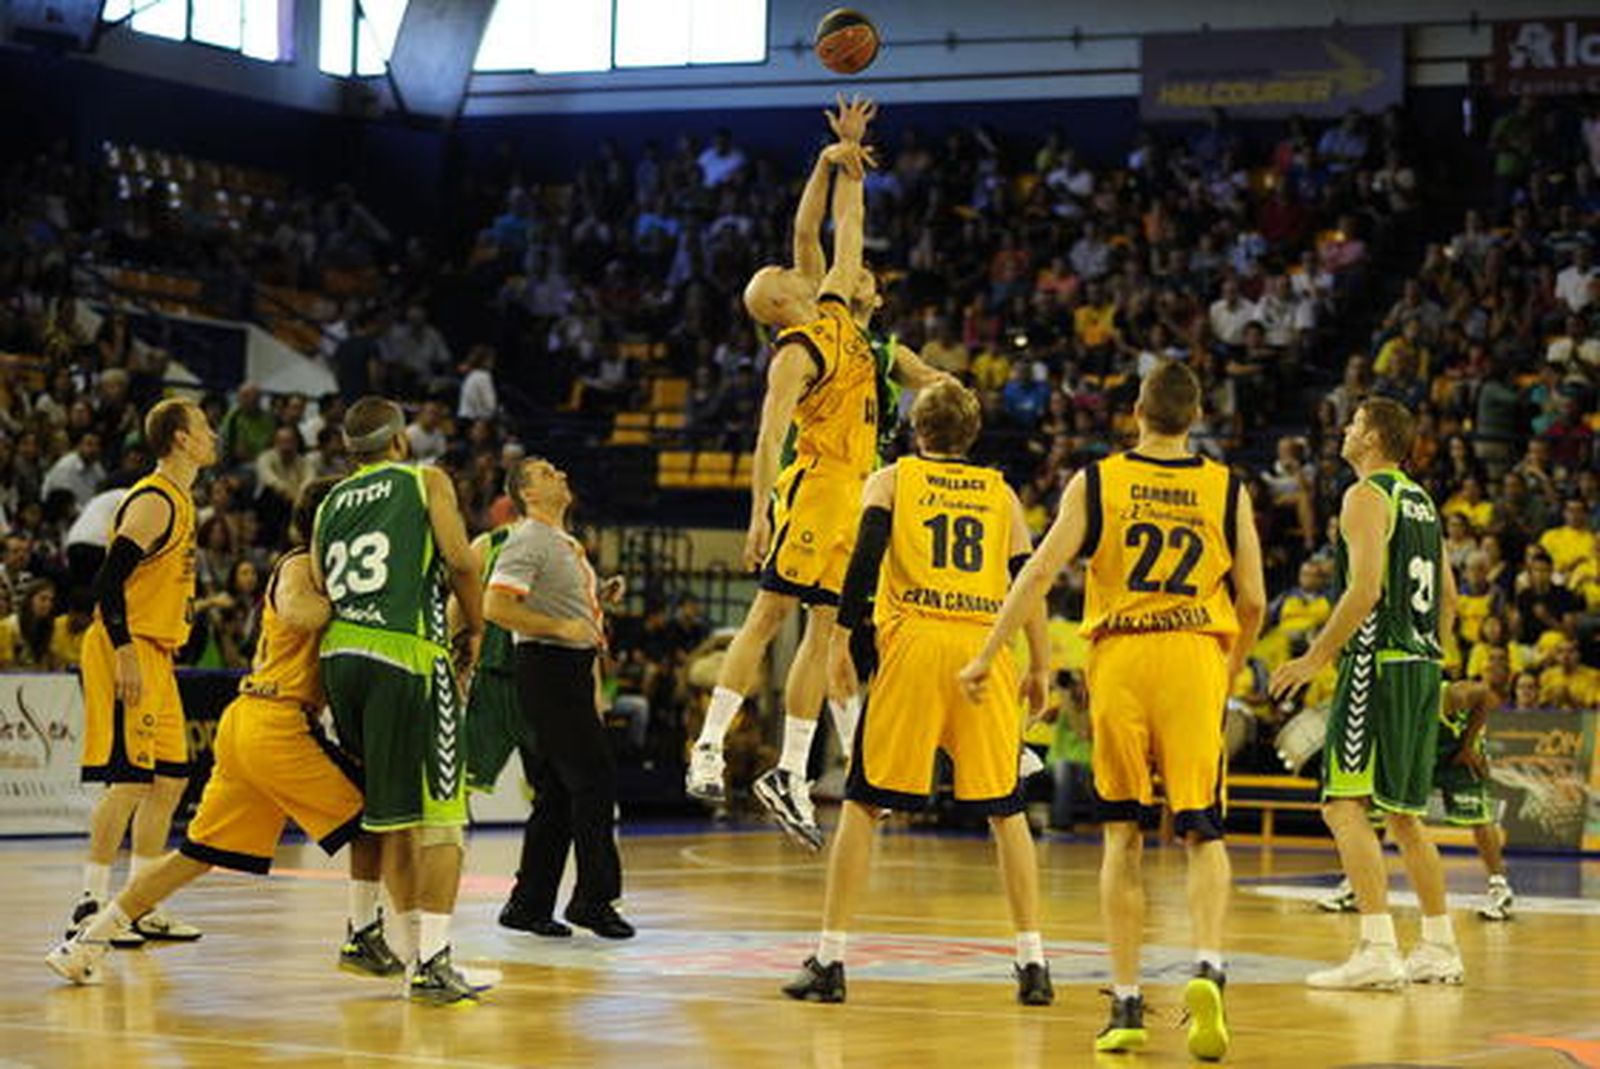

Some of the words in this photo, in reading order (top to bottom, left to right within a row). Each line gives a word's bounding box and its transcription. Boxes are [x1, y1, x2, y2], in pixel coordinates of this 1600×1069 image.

[325, 531, 390, 601] 23
[923, 513, 984, 572] 18
[1125, 522, 1204, 597] 22
